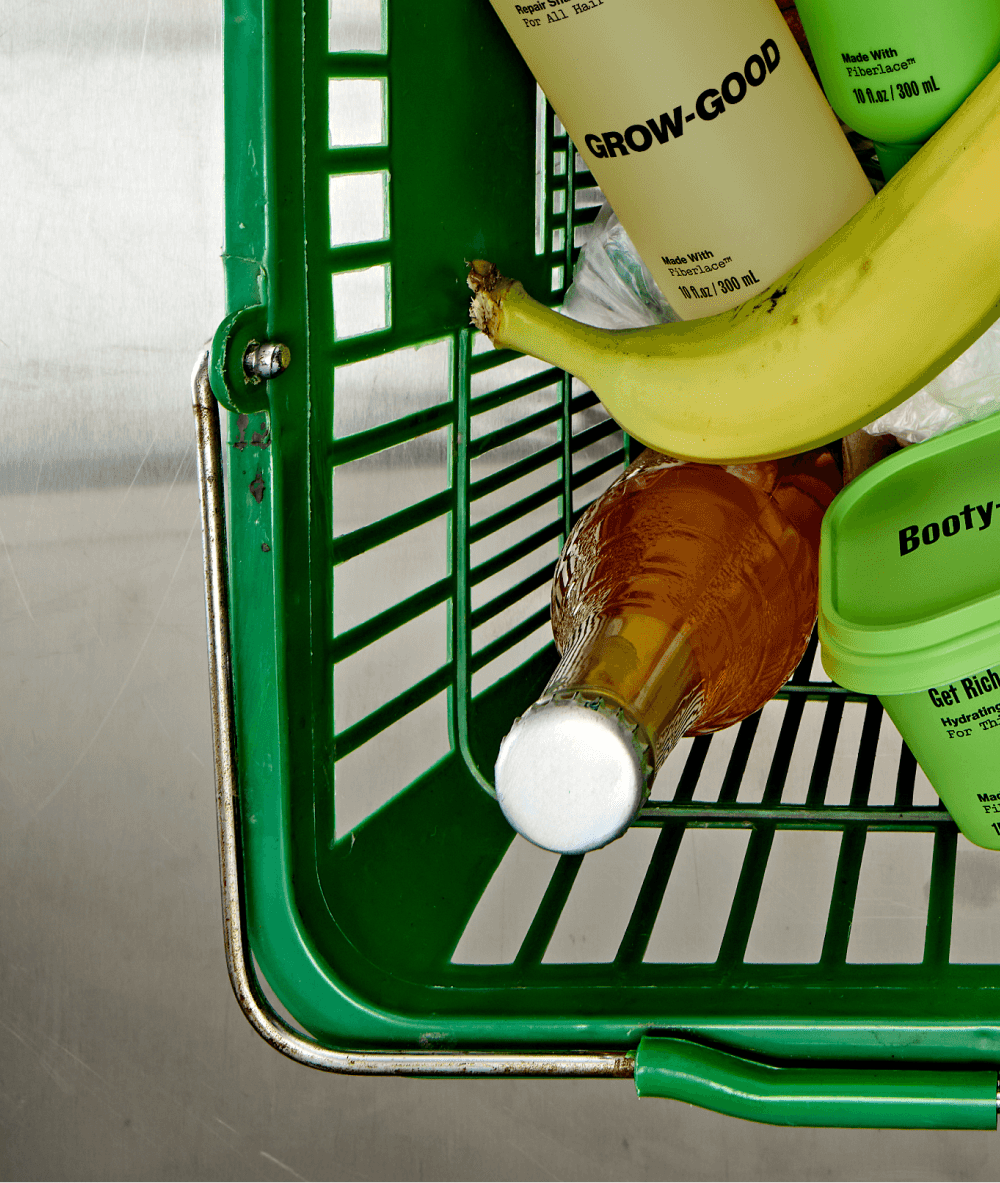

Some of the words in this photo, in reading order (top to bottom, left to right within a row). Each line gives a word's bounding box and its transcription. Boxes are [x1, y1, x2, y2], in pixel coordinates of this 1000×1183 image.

[514, 0, 546, 15] Repair
[522, 18, 541, 28] For
[546, 8, 569, 24] All
[840, 52, 870, 63] Made
[869, 47, 898, 61] With
[584, 38, 781, 159] GROW-GOOD
[852, 88, 866, 104] 10
[895, 80, 920, 99] 300
[921, 75, 940, 94] mL
[660, 255, 688, 265] Made
[686, 249, 714, 262] With
[677, 285, 692, 299] 10
[717, 276, 741, 294] 300
[740, 269, 760, 287] mL
[927, 684, 961, 708] Get
[946, 728, 972, 739] For
